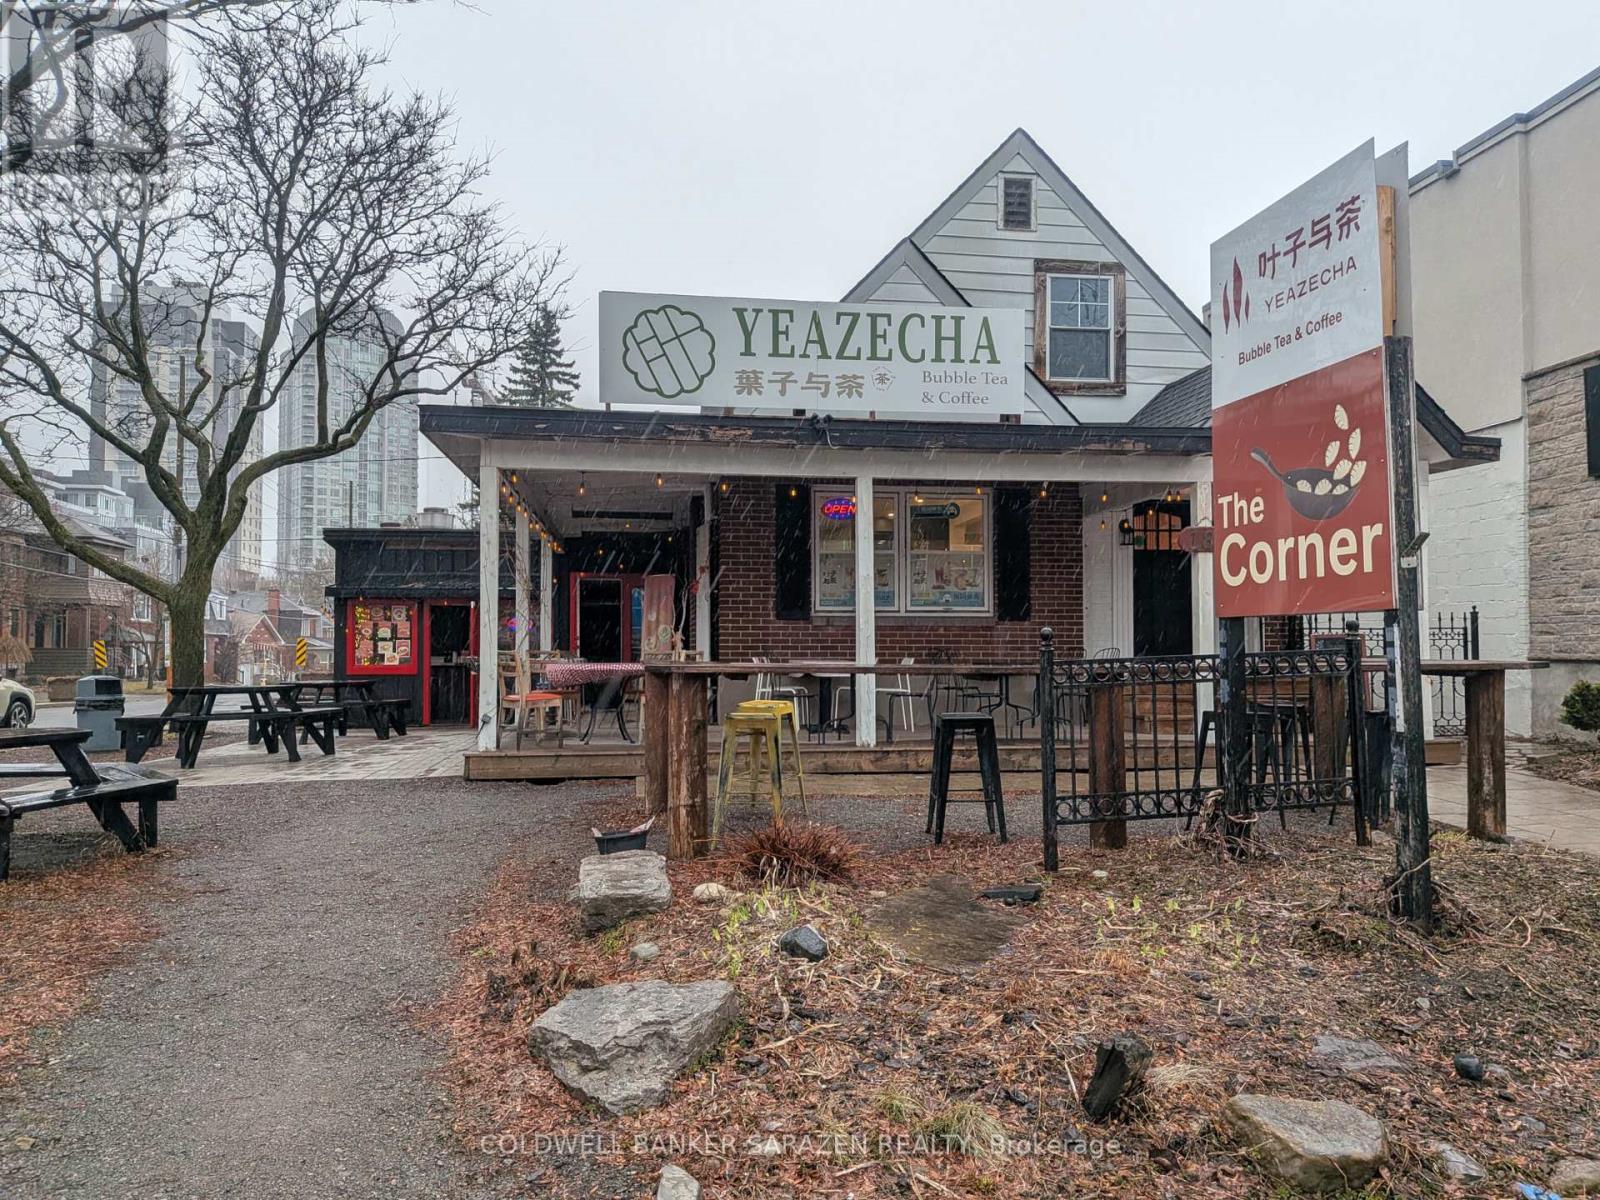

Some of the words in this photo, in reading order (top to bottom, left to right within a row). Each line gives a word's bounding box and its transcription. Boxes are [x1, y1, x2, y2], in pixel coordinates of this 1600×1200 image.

[1258, 194, 1361, 280] 叶子与茶
[1265, 255, 1357, 313] YEAZECHA
[732, 307, 1001, 364] YEAZECHA
[1238, 342, 1272, 366] Bubble
[1274, 333, 1292, 350] Tea
[1294, 326, 1303, 341] &
[1305, 311, 1343, 336] Coffee
[734, 369, 865, 399] 葉子与茶
[921, 391, 935, 404] &
[938, 391, 990, 404] Coffee
[922, 370, 977, 384] Bubble
[980, 371, 1009, 385] Tea
[824, 504, 857, 514] OPEN
[1218, 491, 1265, 529] The
[1220, 523, 1384, 587] Corner
